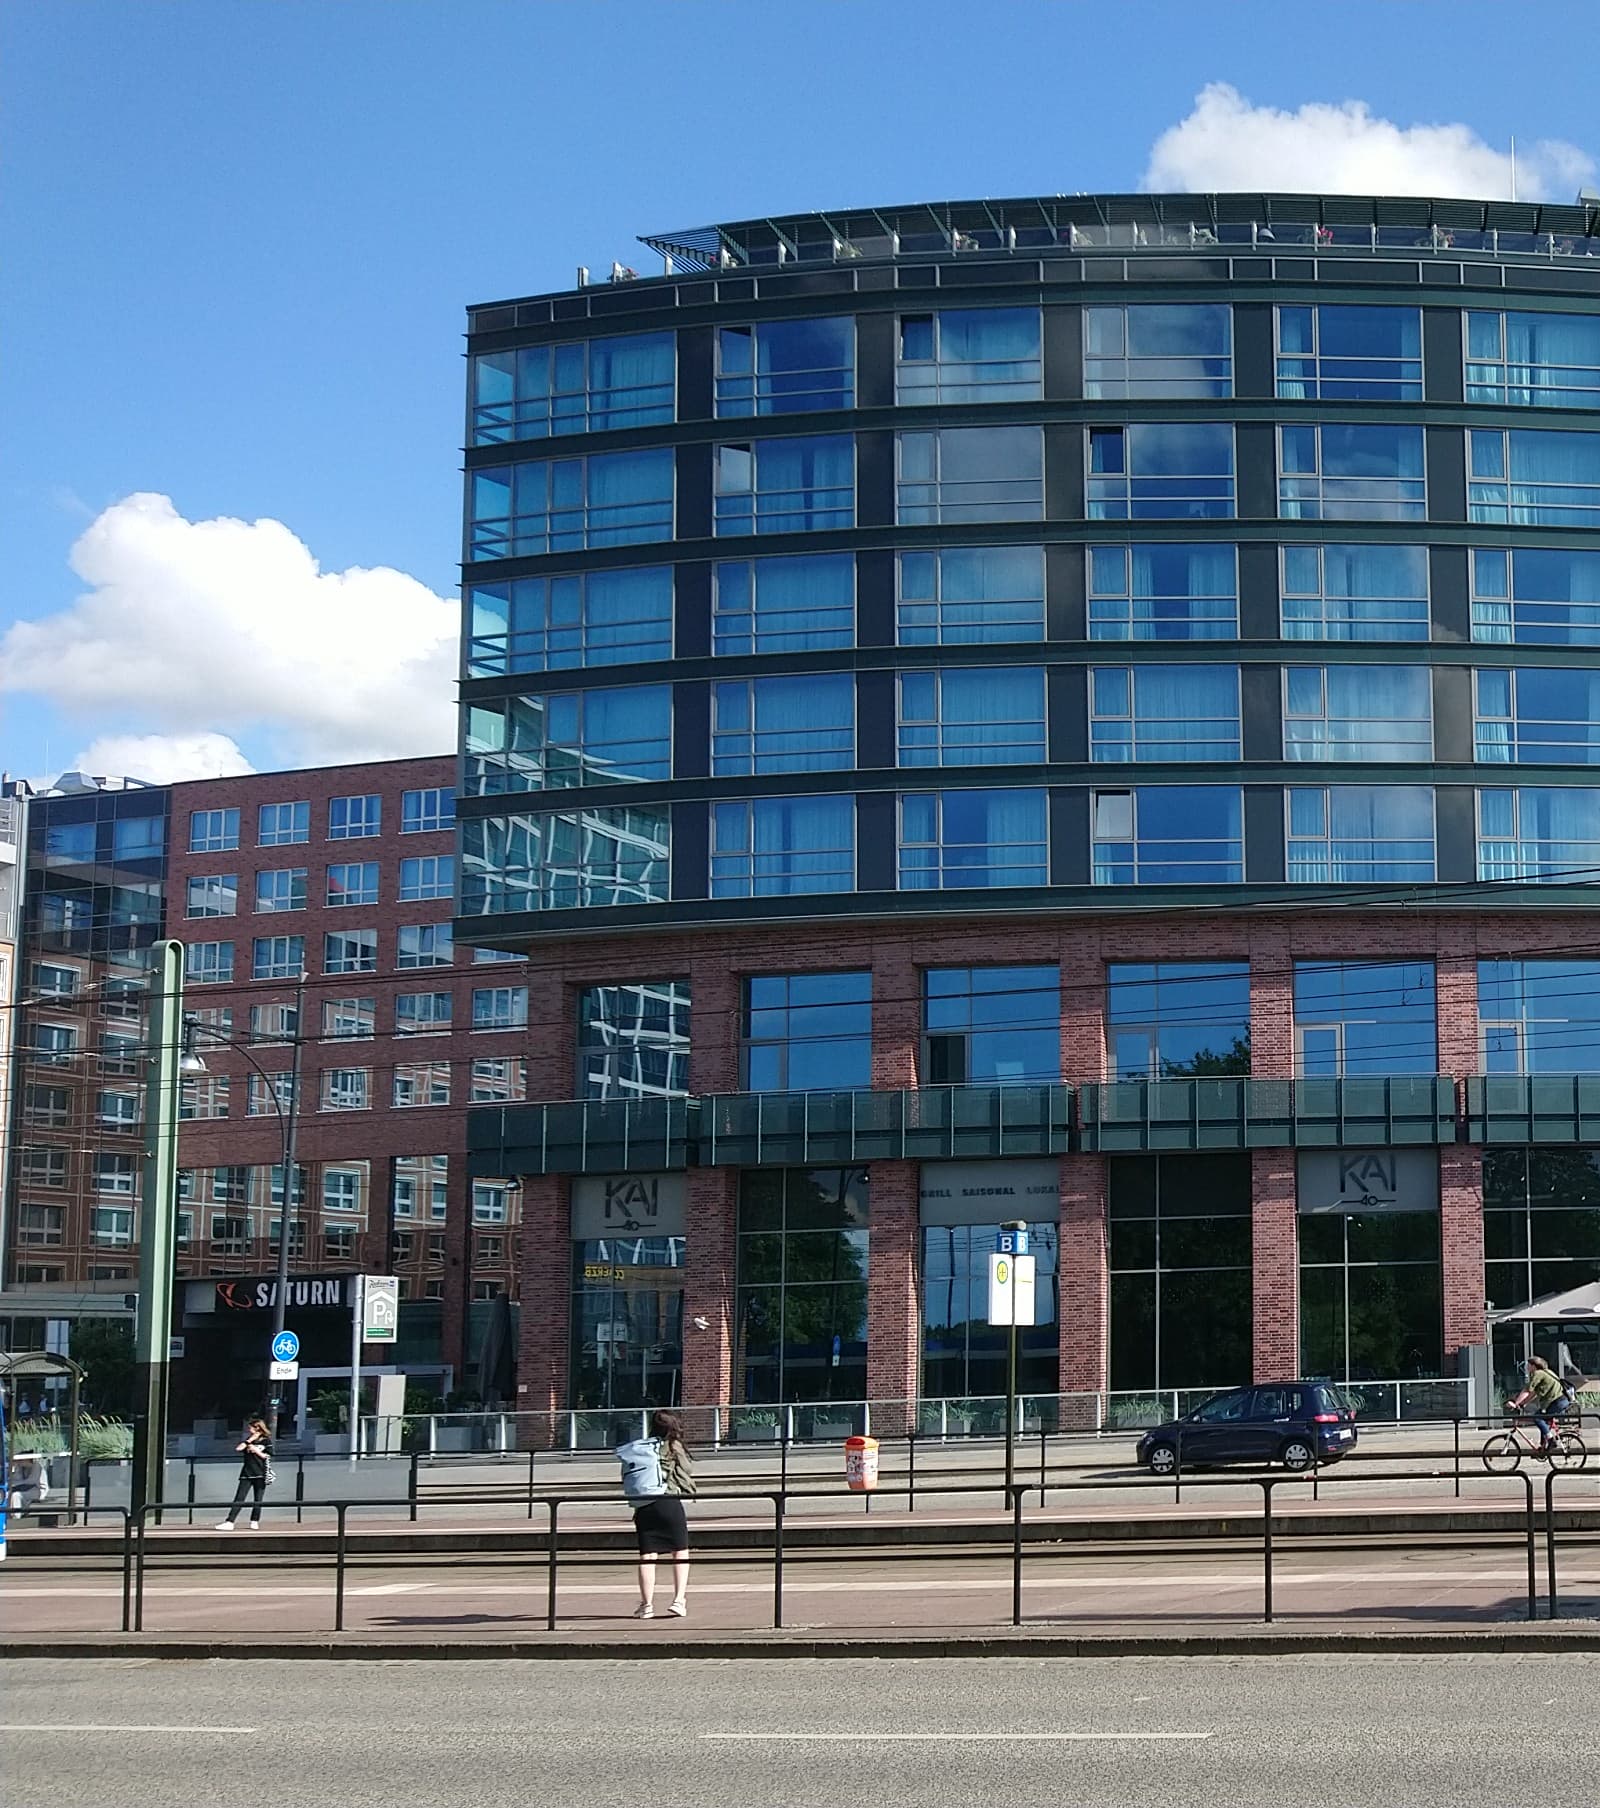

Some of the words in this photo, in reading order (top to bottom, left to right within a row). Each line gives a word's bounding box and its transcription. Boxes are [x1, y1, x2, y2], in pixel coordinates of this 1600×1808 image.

[1339, 1153, 1396, 1193] KAI
[605, 1177, 658, 1218] KAI
[1001, 1237, 1013, 1252] B
[373, 1300, 386, 1325] P
